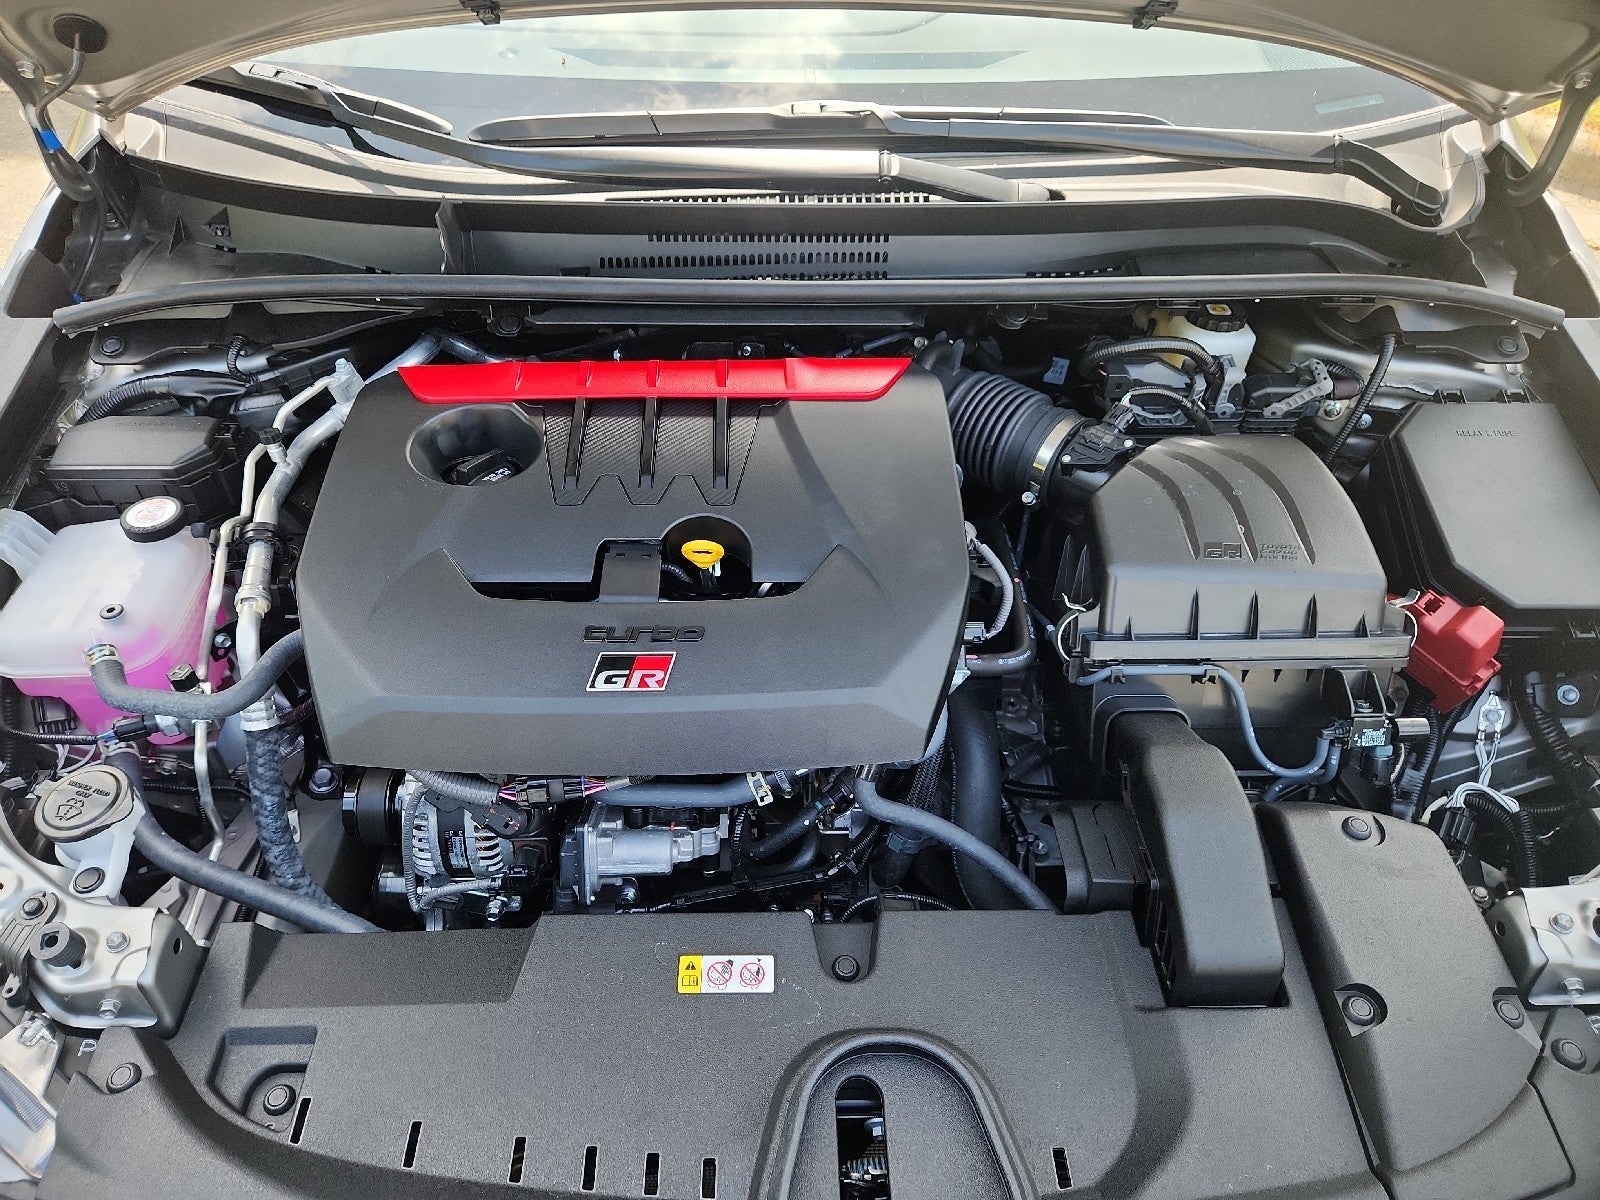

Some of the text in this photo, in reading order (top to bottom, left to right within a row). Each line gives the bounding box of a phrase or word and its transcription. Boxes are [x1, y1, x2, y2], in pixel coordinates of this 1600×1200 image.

[1455, 429, 1483, 437] RELAY
[1493, 429, 1517, 437] FUSE
[1205, 546, 1242, 560] GR
[583, 625, 706, 643] turbo
[594, 669, 666, 690] GR
